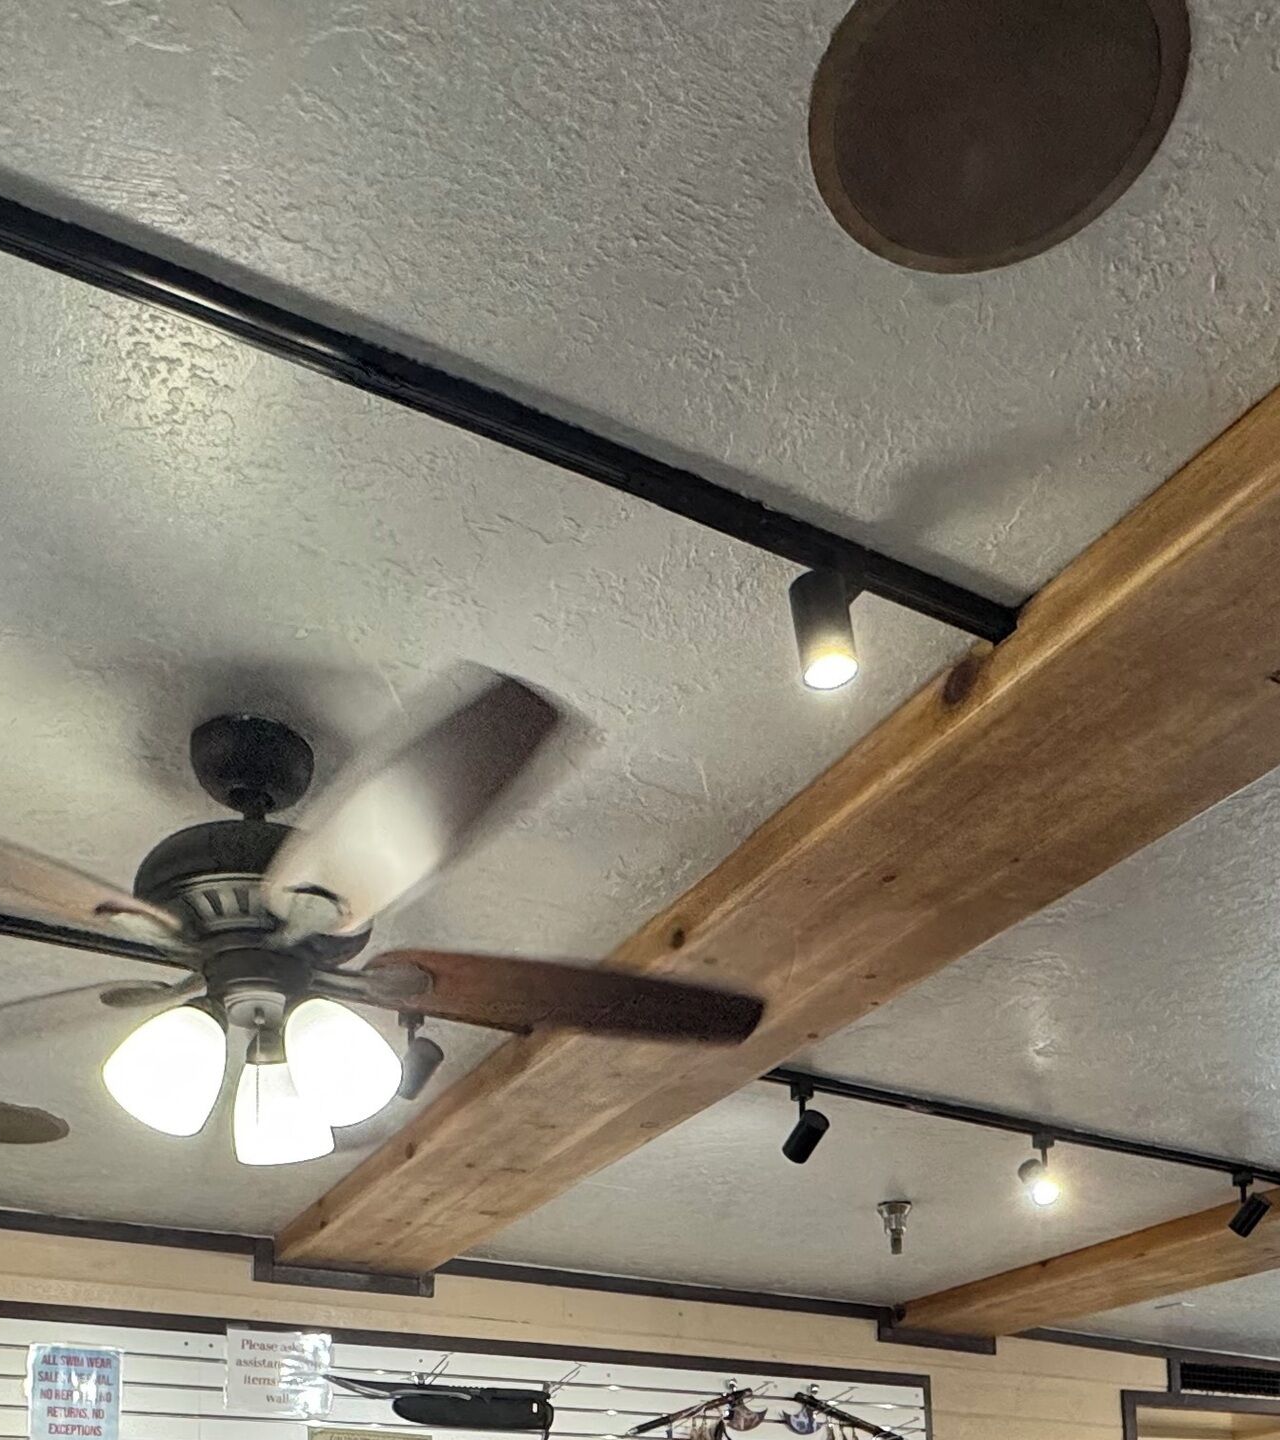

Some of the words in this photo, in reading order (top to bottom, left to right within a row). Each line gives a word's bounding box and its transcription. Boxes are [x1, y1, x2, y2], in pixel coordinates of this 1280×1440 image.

[241, 1338, 278, 1352] Please
[41, 1354, 58, 1366] ALL
[86, 1356, 112, 1369] WEAR
[243, 1374, 276, 1386] items
[40, 1389, 53, 1401] NO
[92, 1408, 105, 1420] NO
[48, 1423, 103, 1436] EXCEPTIONS
